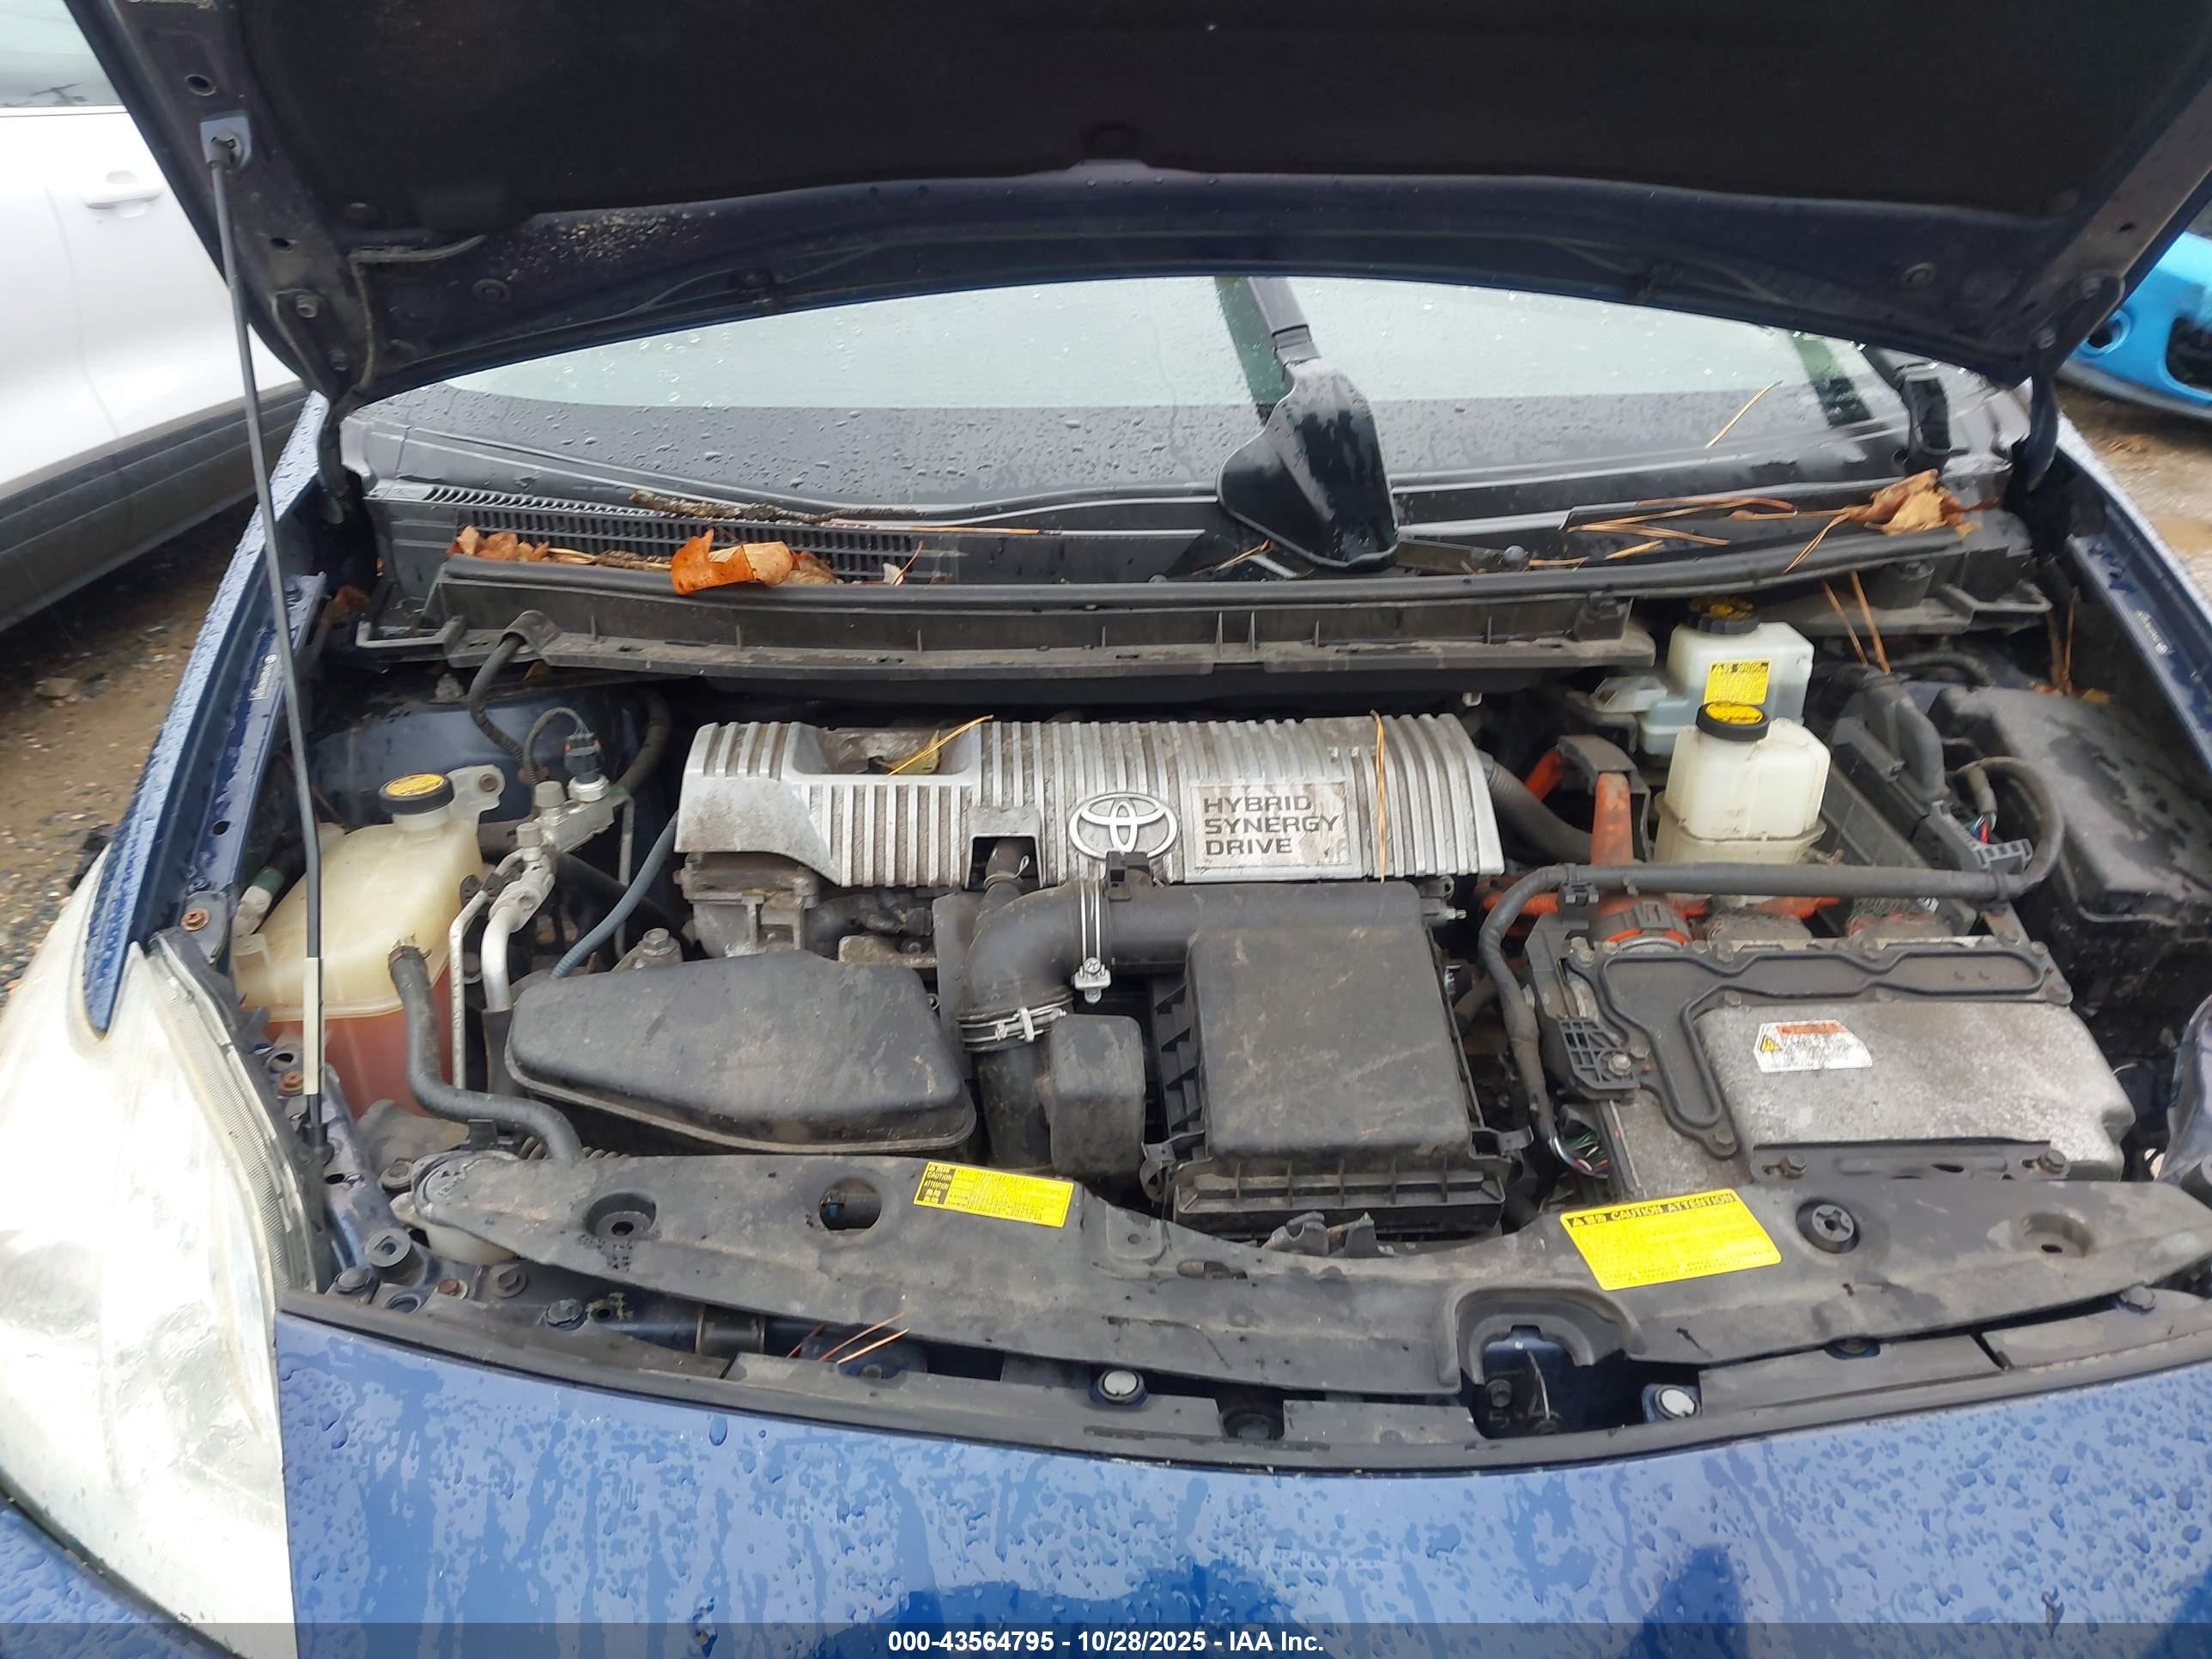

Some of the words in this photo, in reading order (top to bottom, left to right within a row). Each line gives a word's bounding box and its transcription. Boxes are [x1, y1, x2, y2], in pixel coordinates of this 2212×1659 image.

[1203, 796, 1311, 813] HYBRID
[1204, 816, 1339, 835] SYNERGY
[1205, 838, 1292, 856] DRIVE
[927, 1171, 953, 1182] CAUTION
[1610, 1205, 1663, 1222] CAUTION
[1667, 1193, 1737, 1213] ATTENTION
